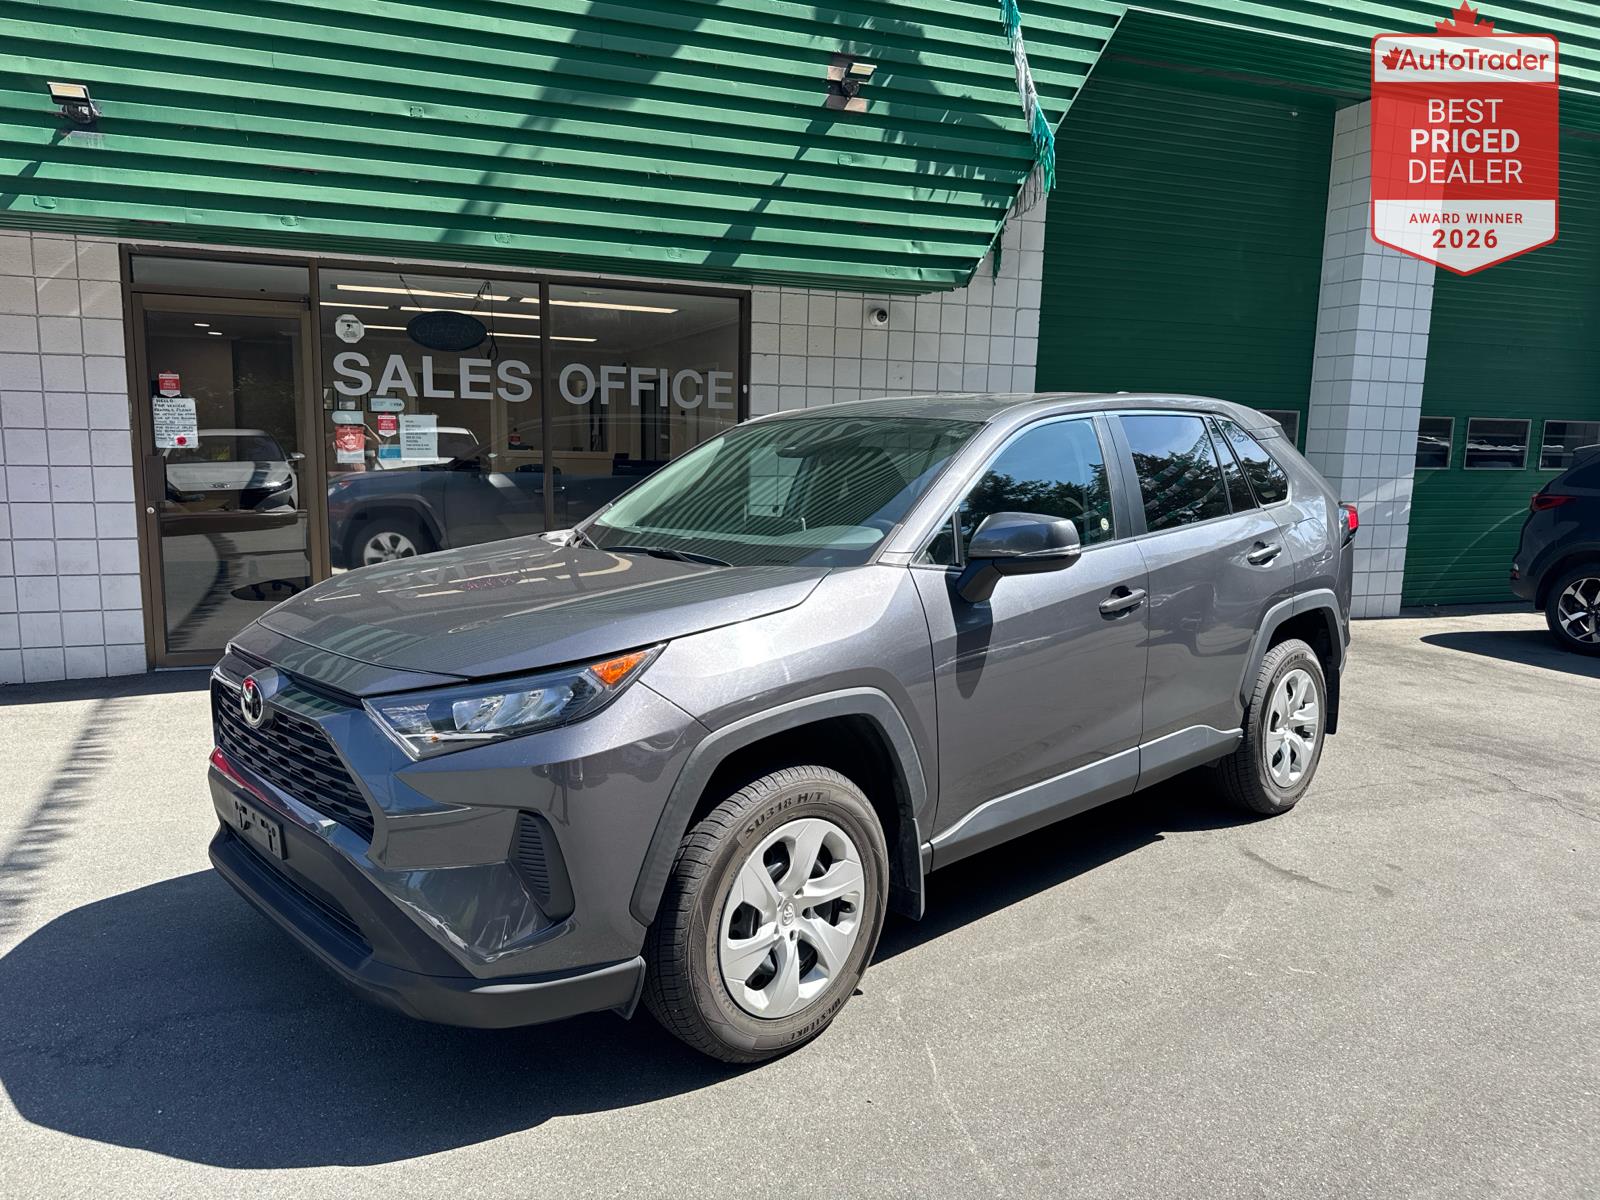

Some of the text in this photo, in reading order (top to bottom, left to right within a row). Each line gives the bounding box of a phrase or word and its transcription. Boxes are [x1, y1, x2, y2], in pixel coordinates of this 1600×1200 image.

[333, 351, 734, 409] SALES OFFICE
[797, 792, 824, 804] H/T
